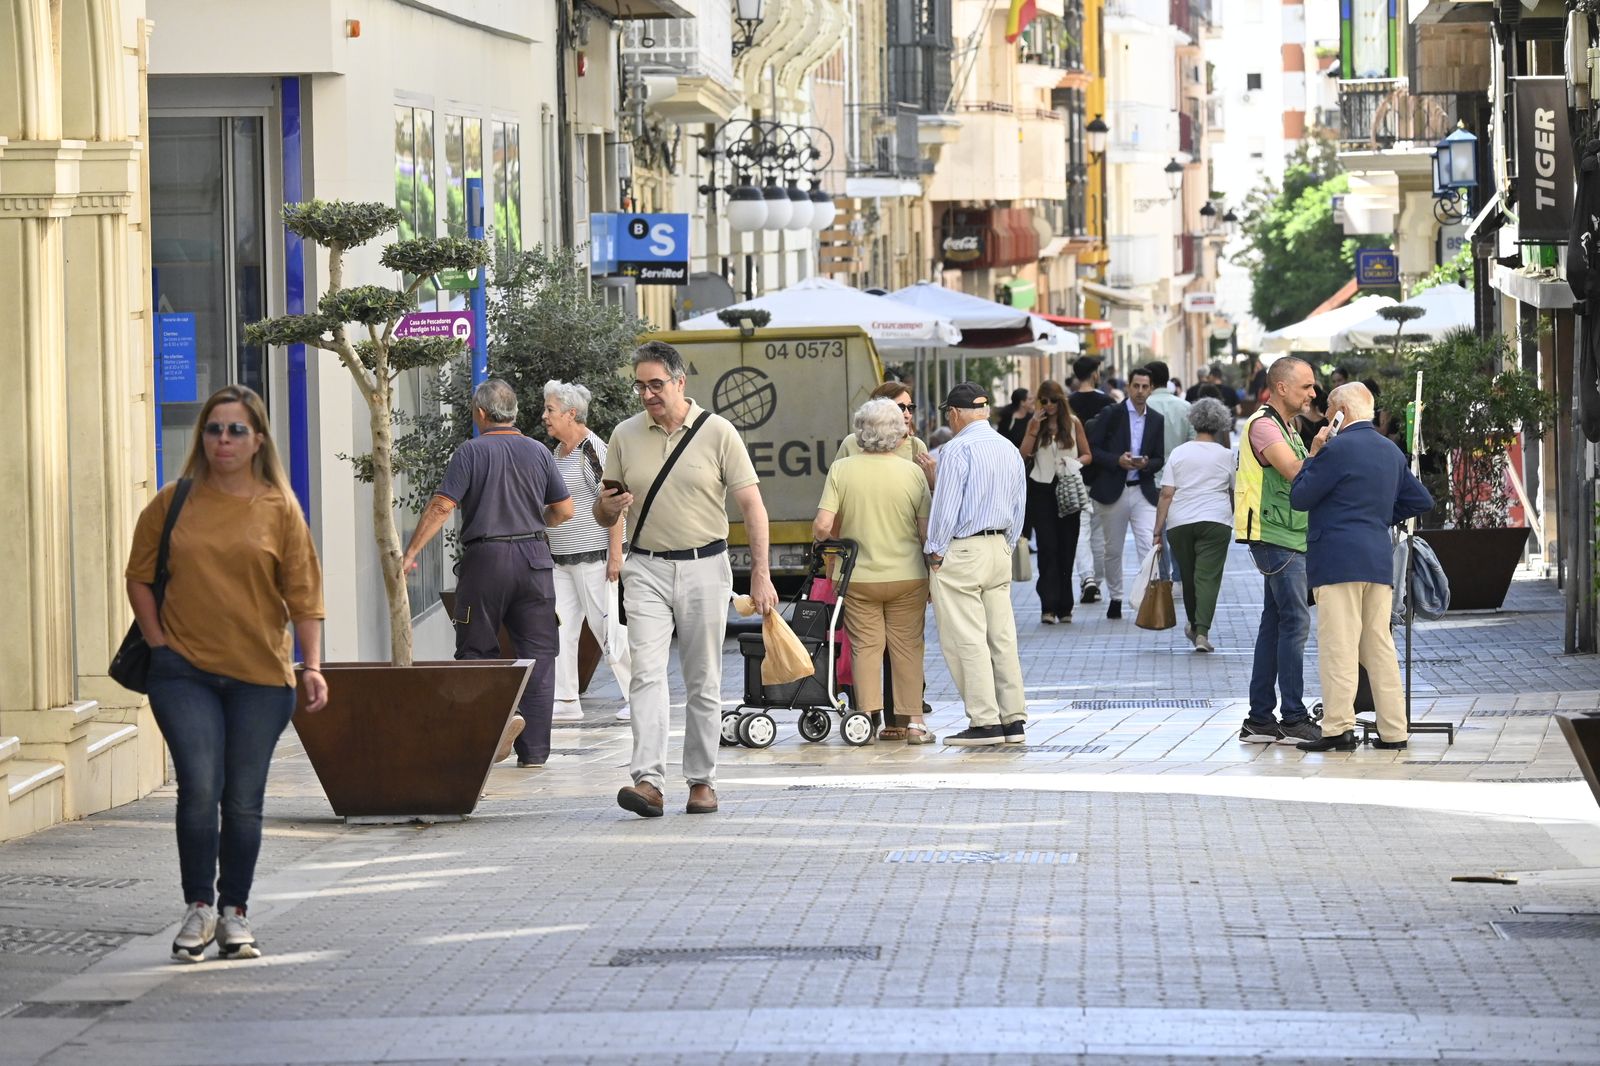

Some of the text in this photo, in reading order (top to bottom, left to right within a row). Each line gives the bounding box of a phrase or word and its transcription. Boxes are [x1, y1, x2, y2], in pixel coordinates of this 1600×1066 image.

[1534, 107, 1556, 211] TIGER
[633, 223, 676, 256] B S
[641, 267, 684, 278] ServiRed
[871, 320, 924, 331] Cruzcampo
[764, 340, 844, 360] 04 0573
[747, 440, 843, 477] EGU
